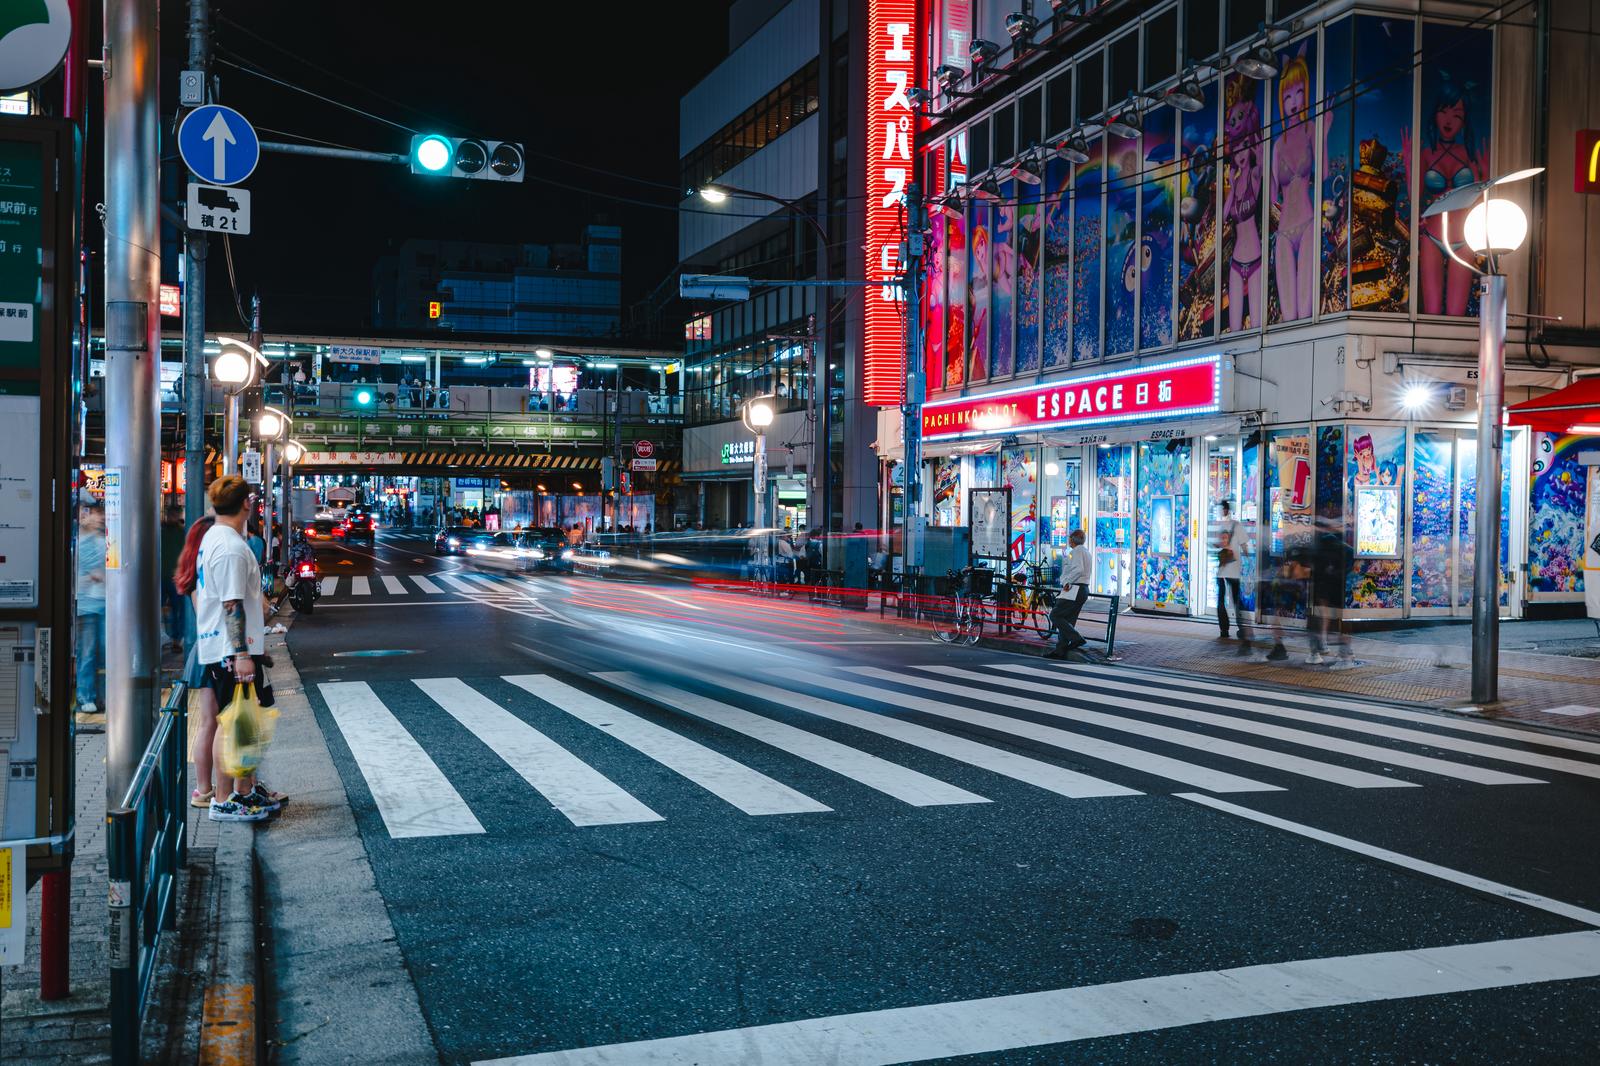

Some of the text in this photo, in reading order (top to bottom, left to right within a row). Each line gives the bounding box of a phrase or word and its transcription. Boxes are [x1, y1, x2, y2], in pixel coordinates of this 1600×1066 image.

[882, 23, 911, 209] エスパス
[0, 201, 27, 215] 駅前
[1036, 379, 1172, 418] ESPACE 日拓
[1151, 429, 1174, 439] ESPACE
[729, 441, 754, 455] 新大久保駅
